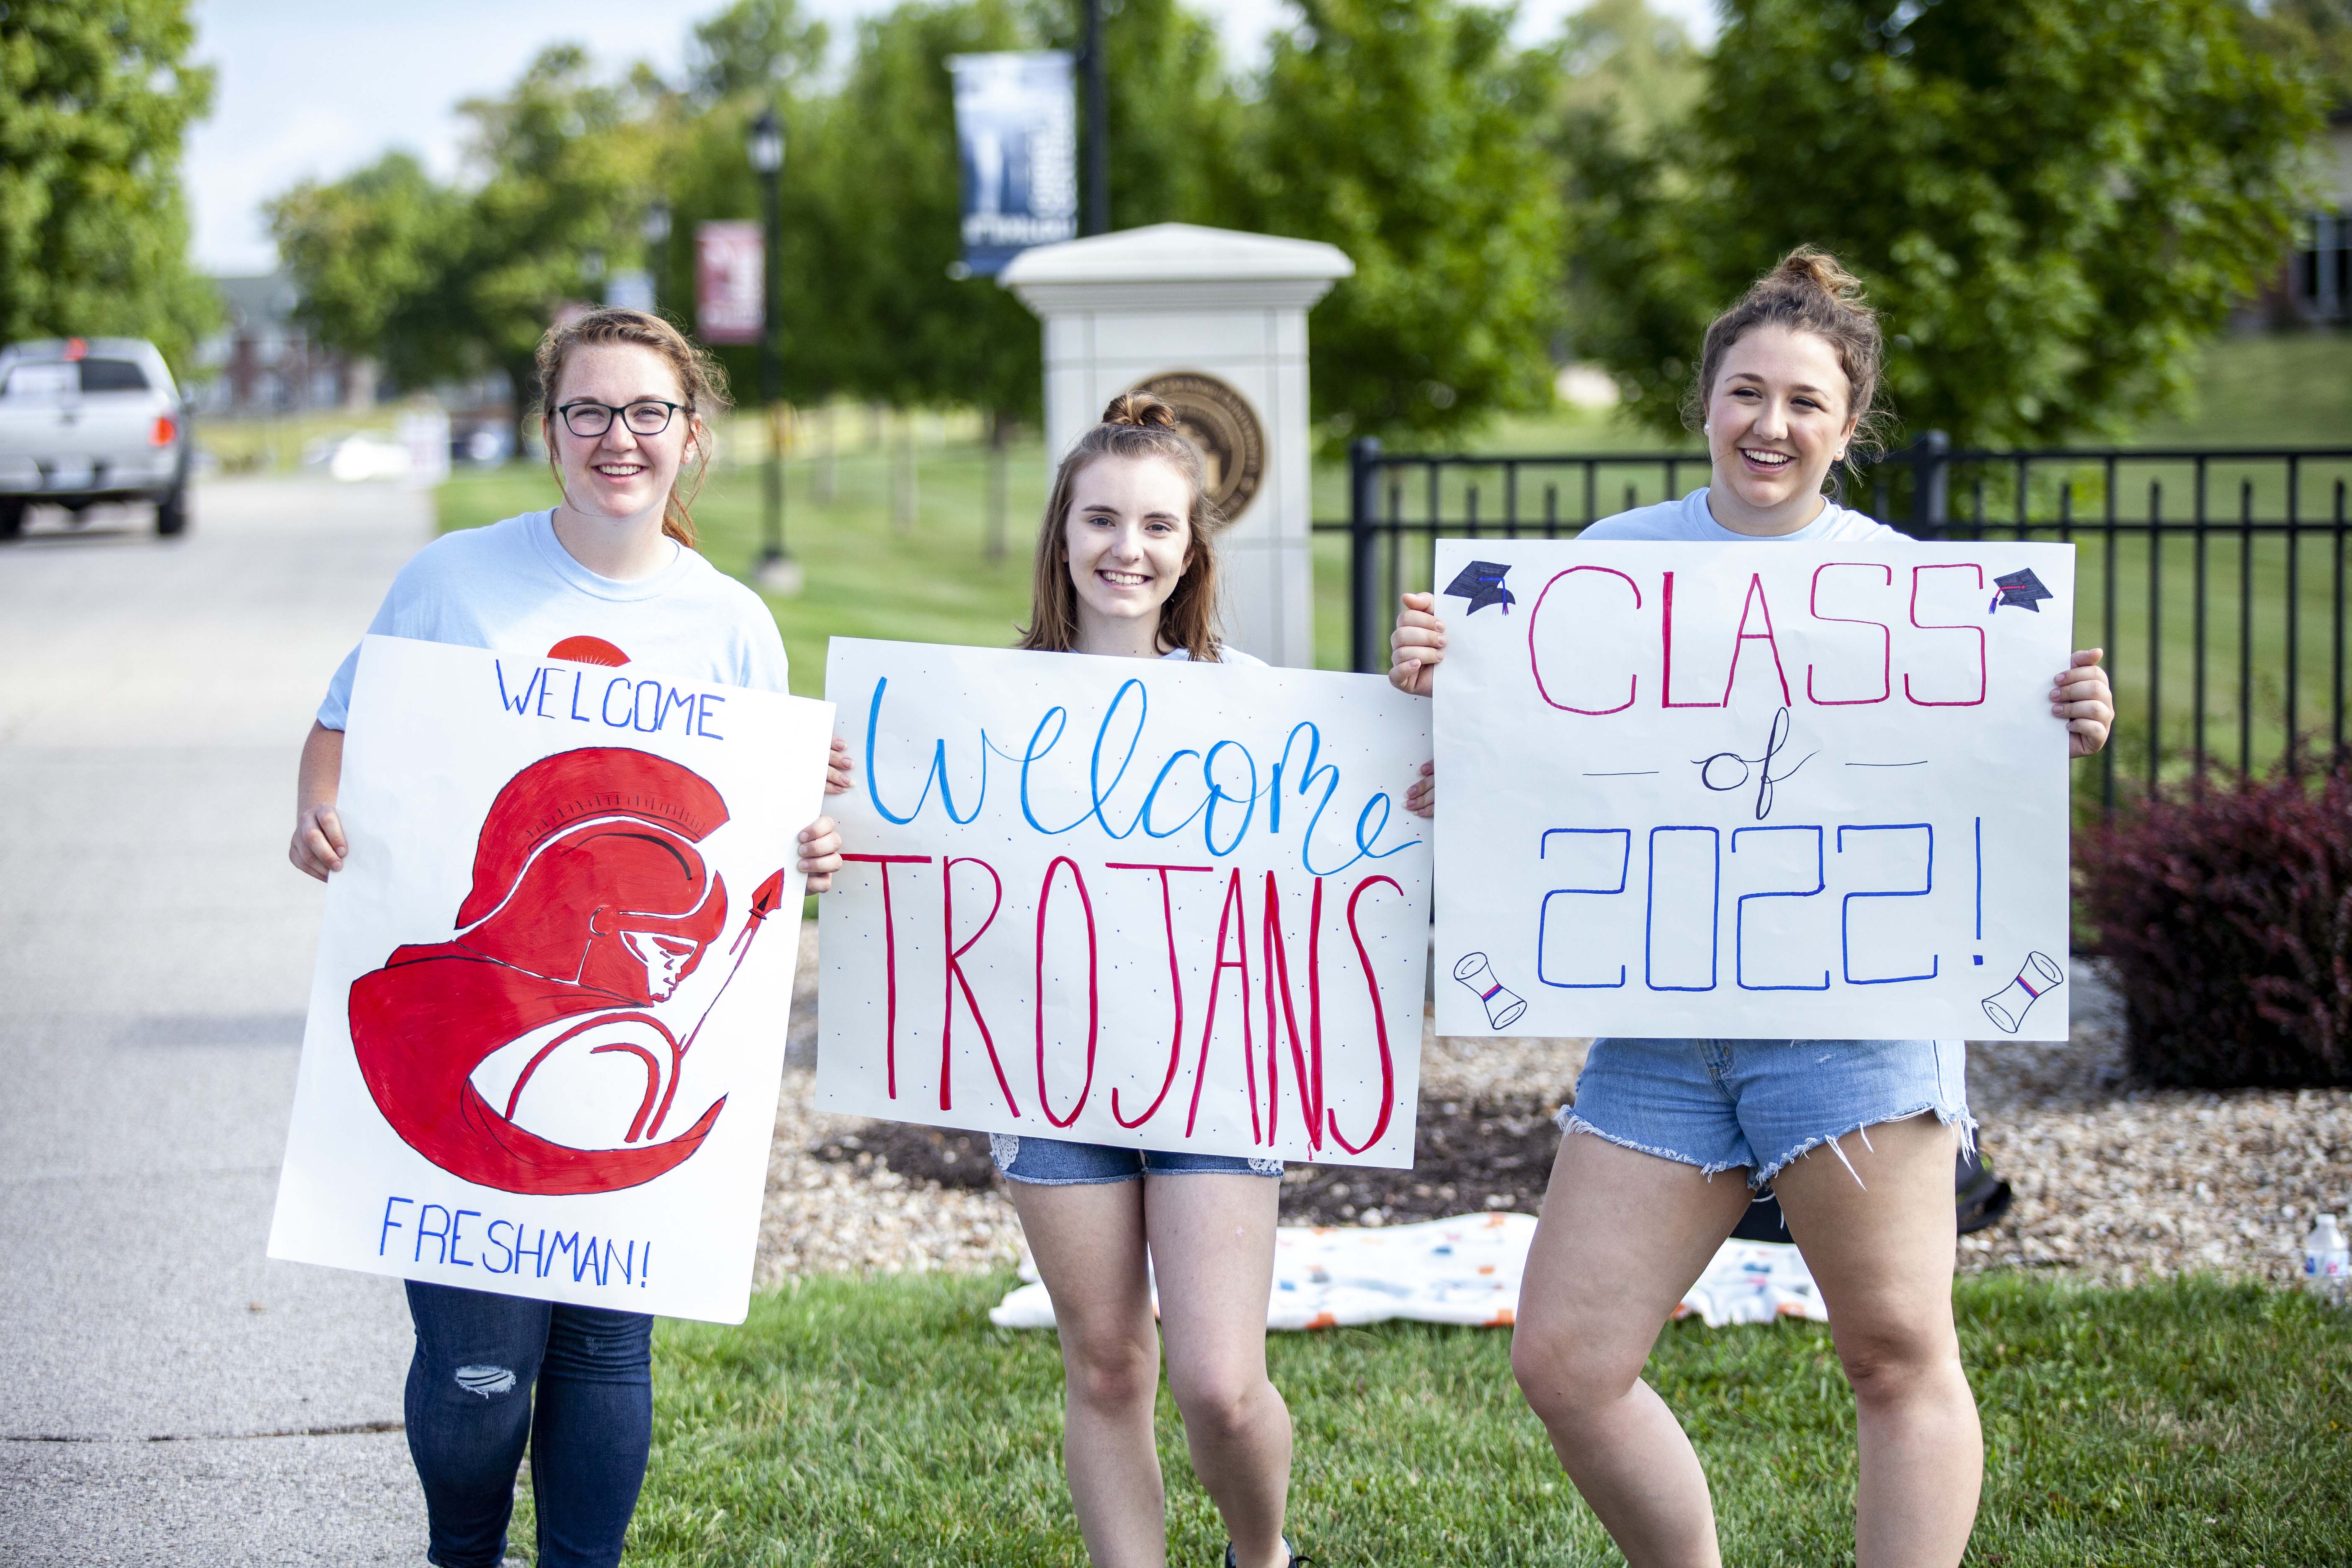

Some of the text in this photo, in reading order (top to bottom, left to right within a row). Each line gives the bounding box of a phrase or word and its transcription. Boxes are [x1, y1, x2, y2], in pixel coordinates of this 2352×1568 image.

[495, 658, 727, 741] WELCOME
[1528, 562, 1986, 715] CLASS
[1690, 707, 1821, 820] of
[1538, 816, 1984, 991] 2022!
[841, 855, 1404, 1159] TROJANS
[379, 1196, 652, 1289] FRESHMAN!
